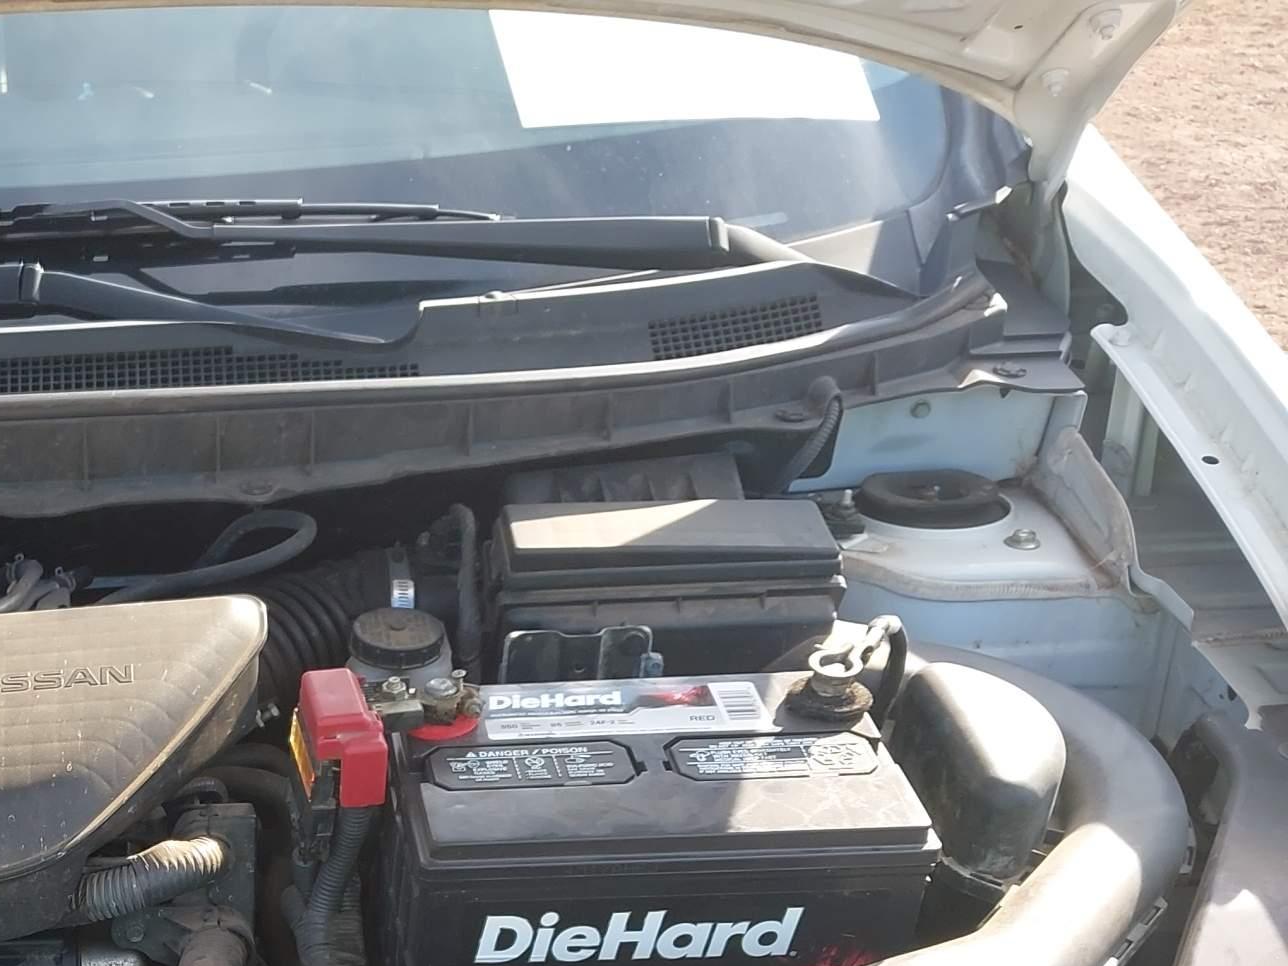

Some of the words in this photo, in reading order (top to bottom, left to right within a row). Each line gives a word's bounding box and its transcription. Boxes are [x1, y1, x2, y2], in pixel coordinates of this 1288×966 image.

[488, 691, 622, 710] DieHard
[478, 749, 529, 758] DANGER
[542, 747, 588, 755] POISON
[474, 906, 806, 964] DieHard
